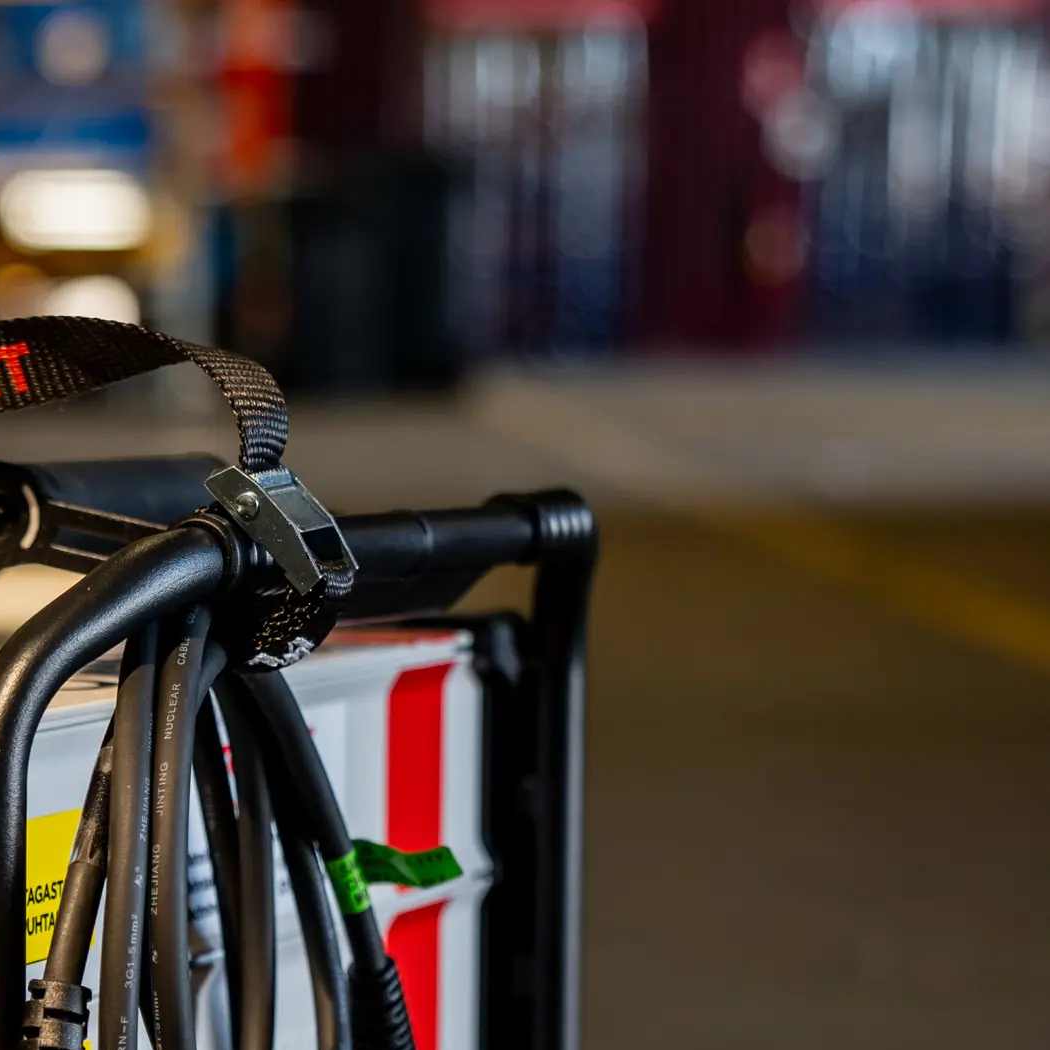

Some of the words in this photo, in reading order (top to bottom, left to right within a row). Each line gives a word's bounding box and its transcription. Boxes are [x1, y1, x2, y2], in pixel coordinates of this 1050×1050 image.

[150, 844, 162, 915] ZHEJIANG
[156, 762, 168, 816] JINTING
[164, 683, 181, 740] NUCLEAR
[26, 880, 63, 906] AGAST
[26, 912, 57, 936] UHTA
